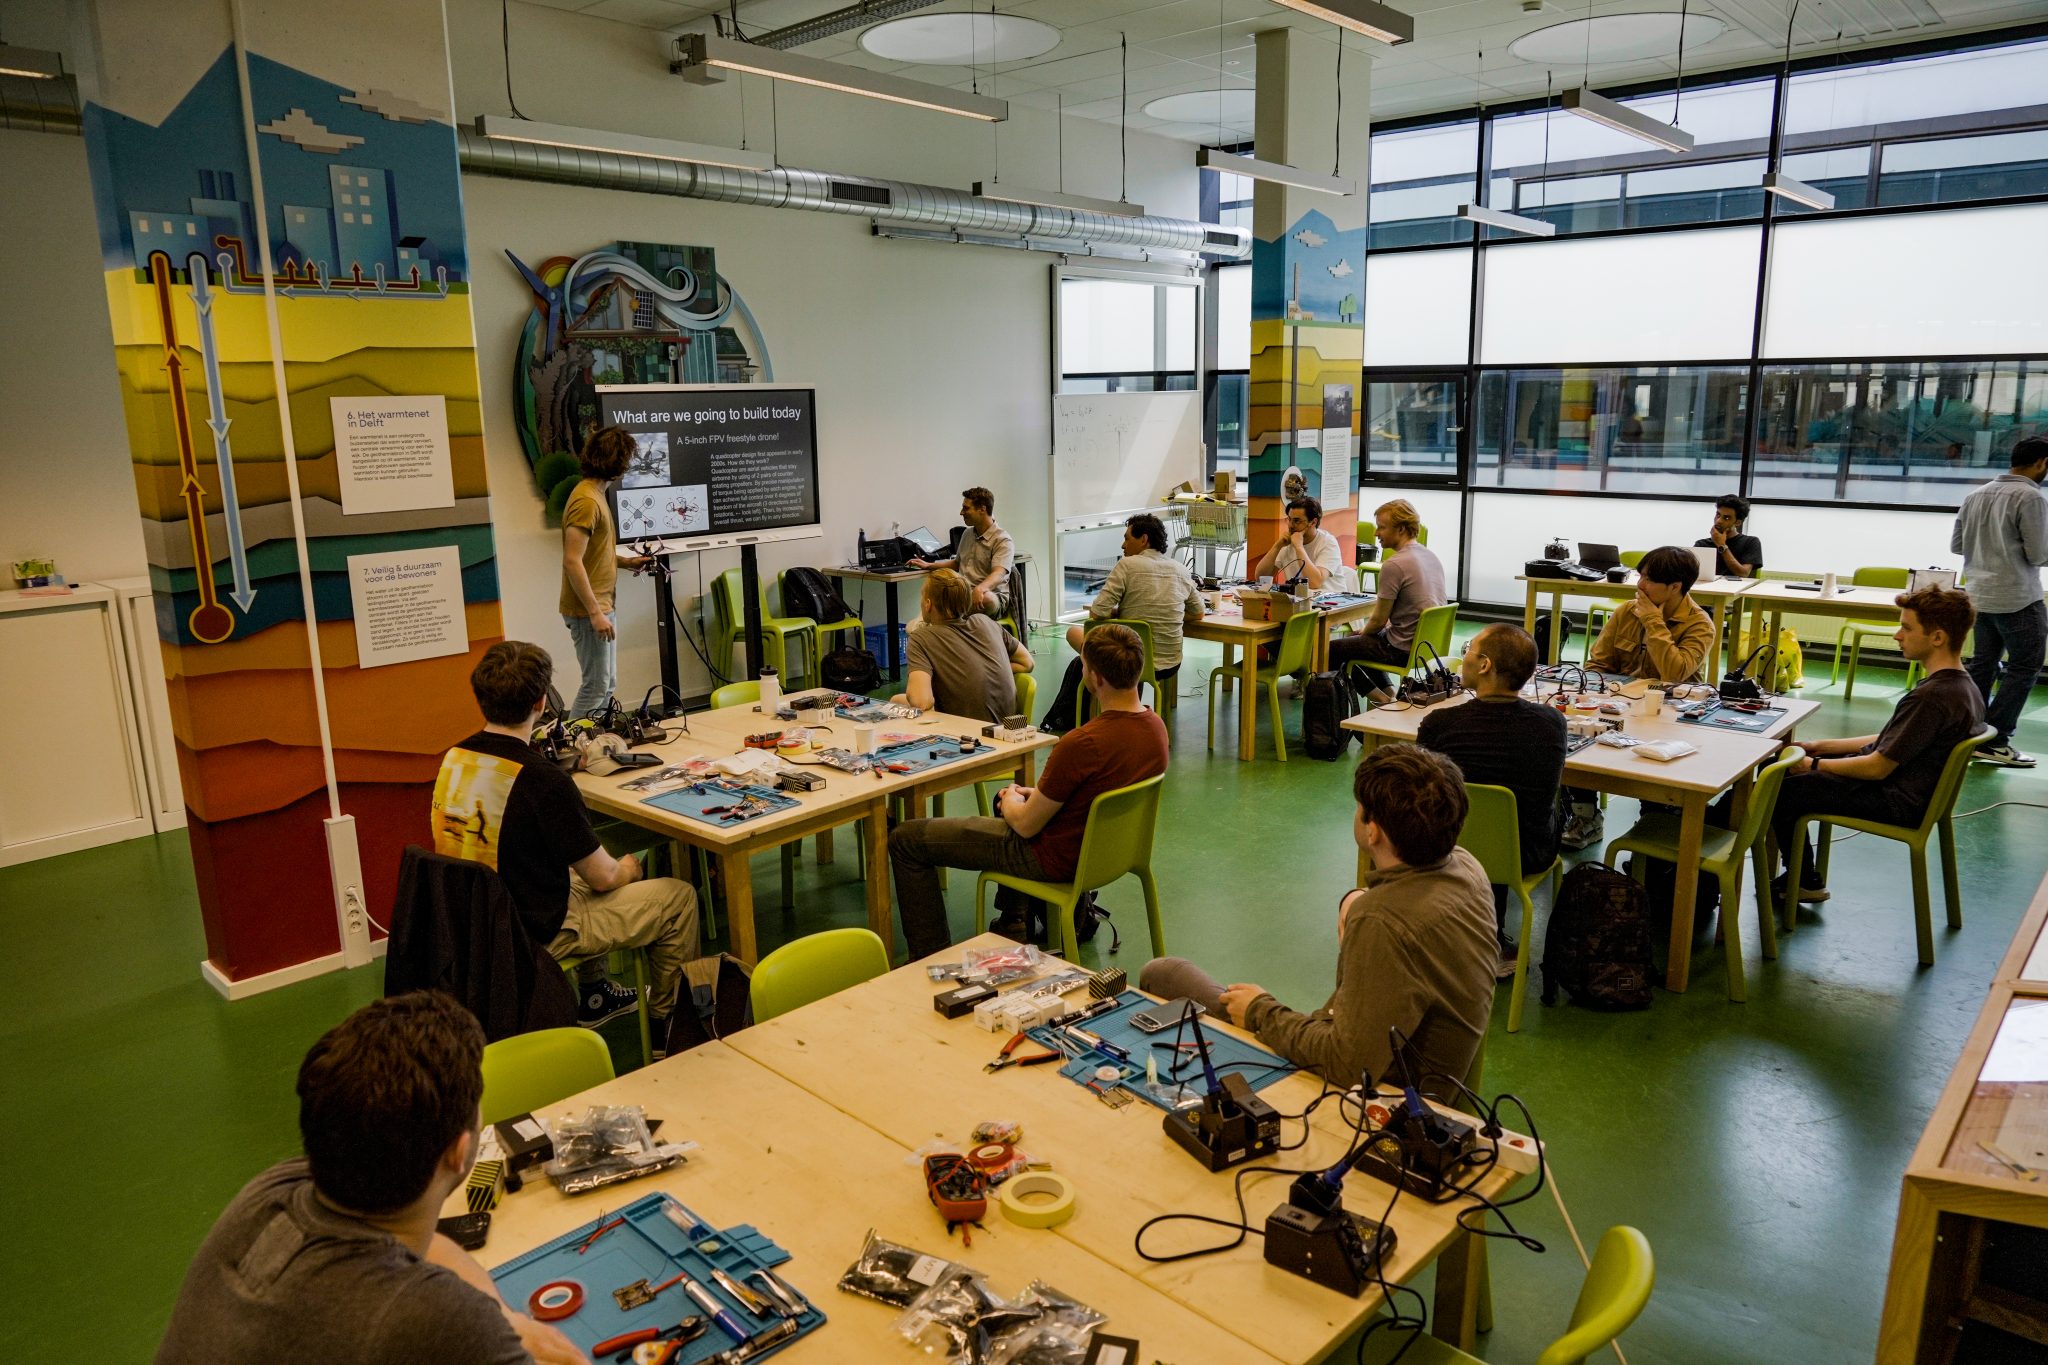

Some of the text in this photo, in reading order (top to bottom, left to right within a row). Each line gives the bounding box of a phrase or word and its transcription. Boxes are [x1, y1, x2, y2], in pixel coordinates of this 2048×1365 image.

[358, 411, 375, 419] Het
[378, 410, 430, 419] warmtenet
[614, 406, 801, 424] What are we going to build today
[348, 419, 384, 428] in Delft
[677, 432, 780, 445] A 5-inch FPV freestyle drone!
[403, 562, 442, 571] duurzaam
[398, 570, 436, 580] bewoners
